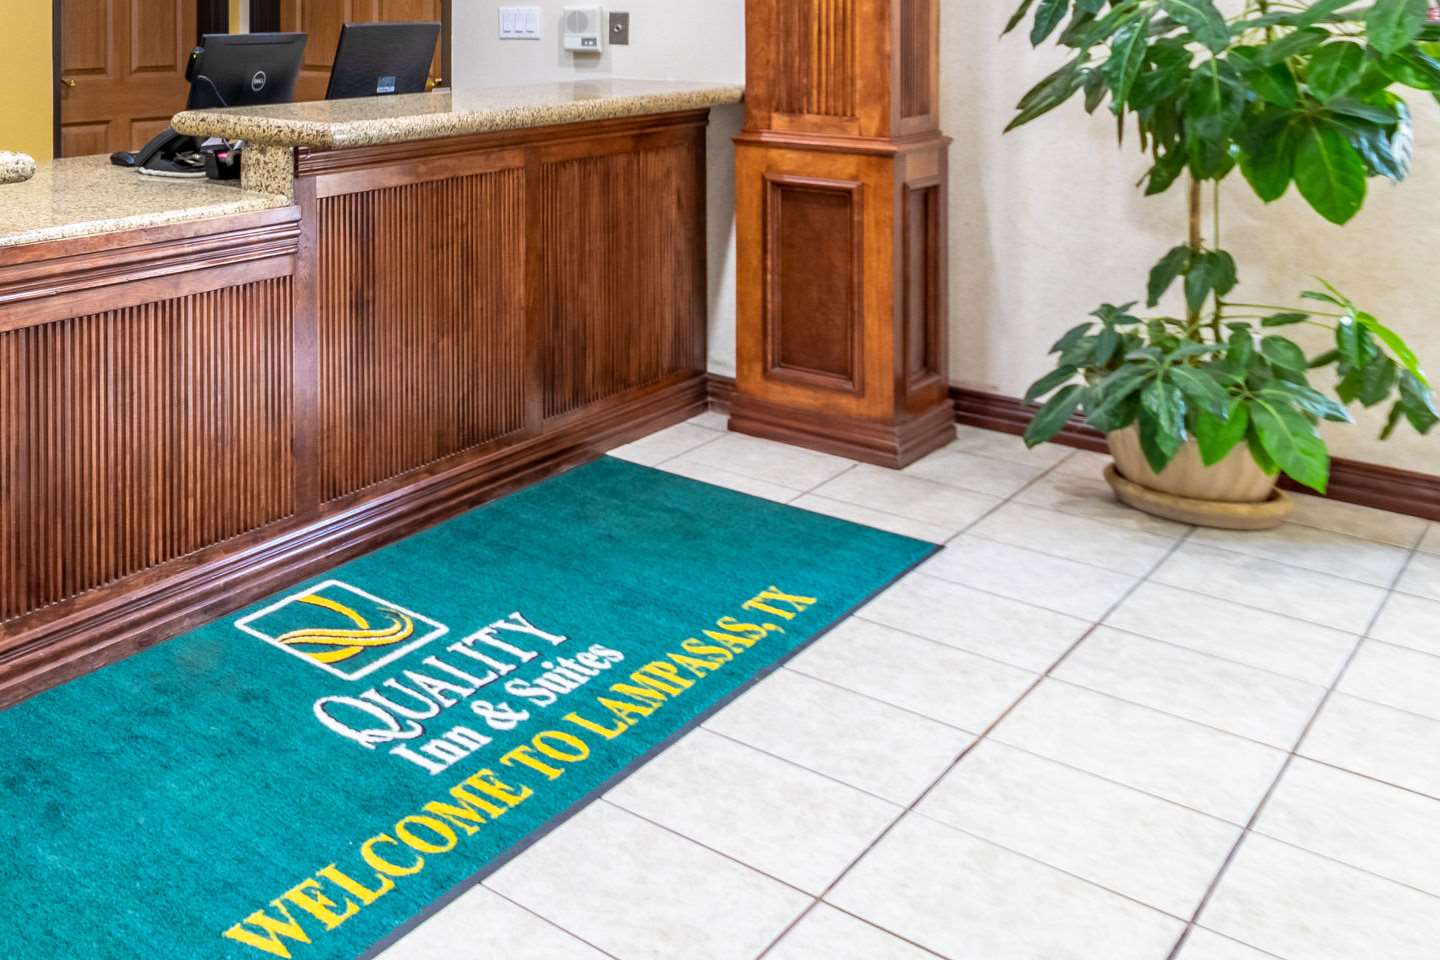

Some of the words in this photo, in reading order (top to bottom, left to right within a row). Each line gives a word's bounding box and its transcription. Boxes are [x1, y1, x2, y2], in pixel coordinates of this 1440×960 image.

[313, 611, 568, 749] QUALITY
[389, 725, 493, 775] Inn
[470, 699, 530, 730] &
[504, 643, 625, 708] Suites
[222, 768, 534, 959] WELCOME
[500, 730, 591, 780] TO
[562, 616, 786, 740] LAMPASAS,
[741, 585, 817, 620] TX
